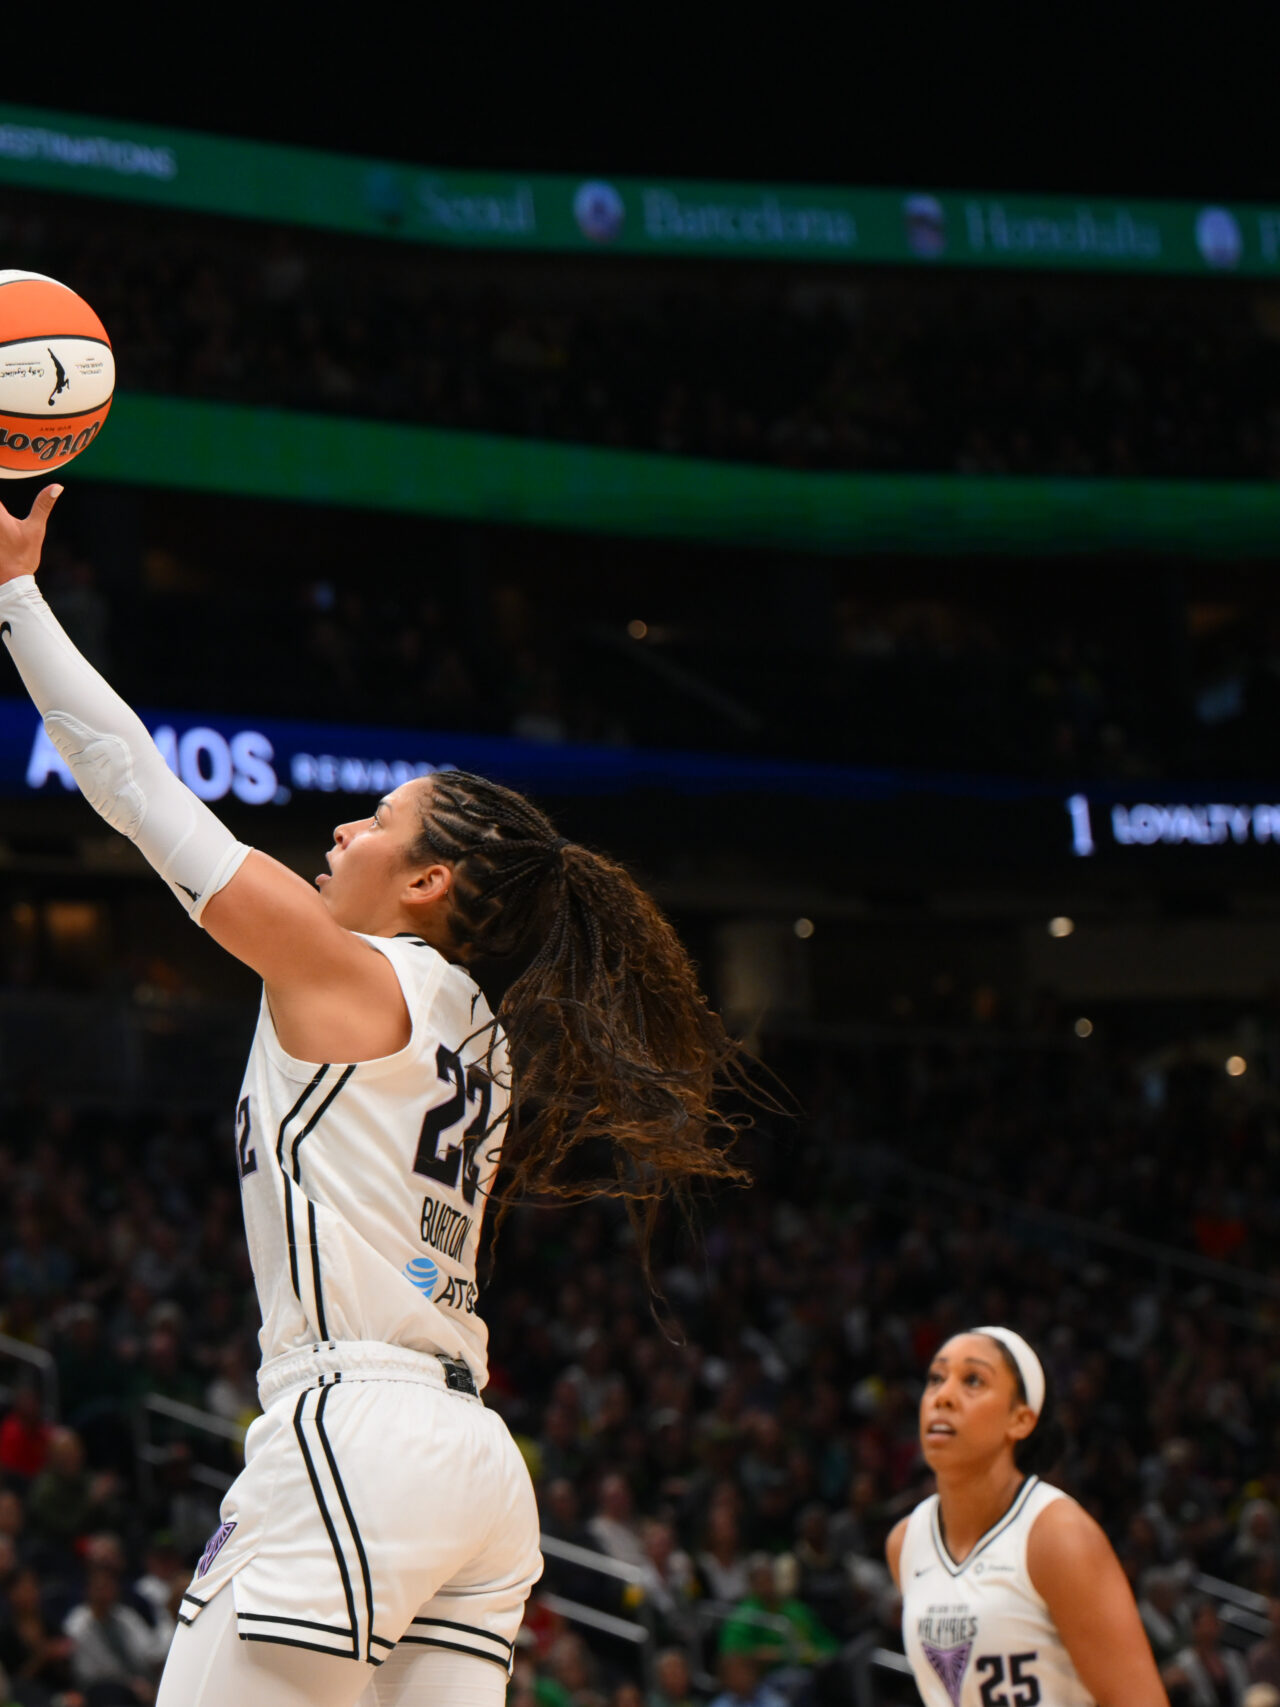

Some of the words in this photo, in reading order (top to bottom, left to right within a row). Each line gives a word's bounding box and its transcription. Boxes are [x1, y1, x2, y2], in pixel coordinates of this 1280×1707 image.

[642, 186, 858, 247] Barcelona
[289, 752, 458, 794] REWAR
[1111, 802, 1251, 845] LOYALTY
[412, 1042, 492, 1208] 22
[420, 1196, 474, 1263] BURTON
[976, 1650, 1041, 1707] 25
